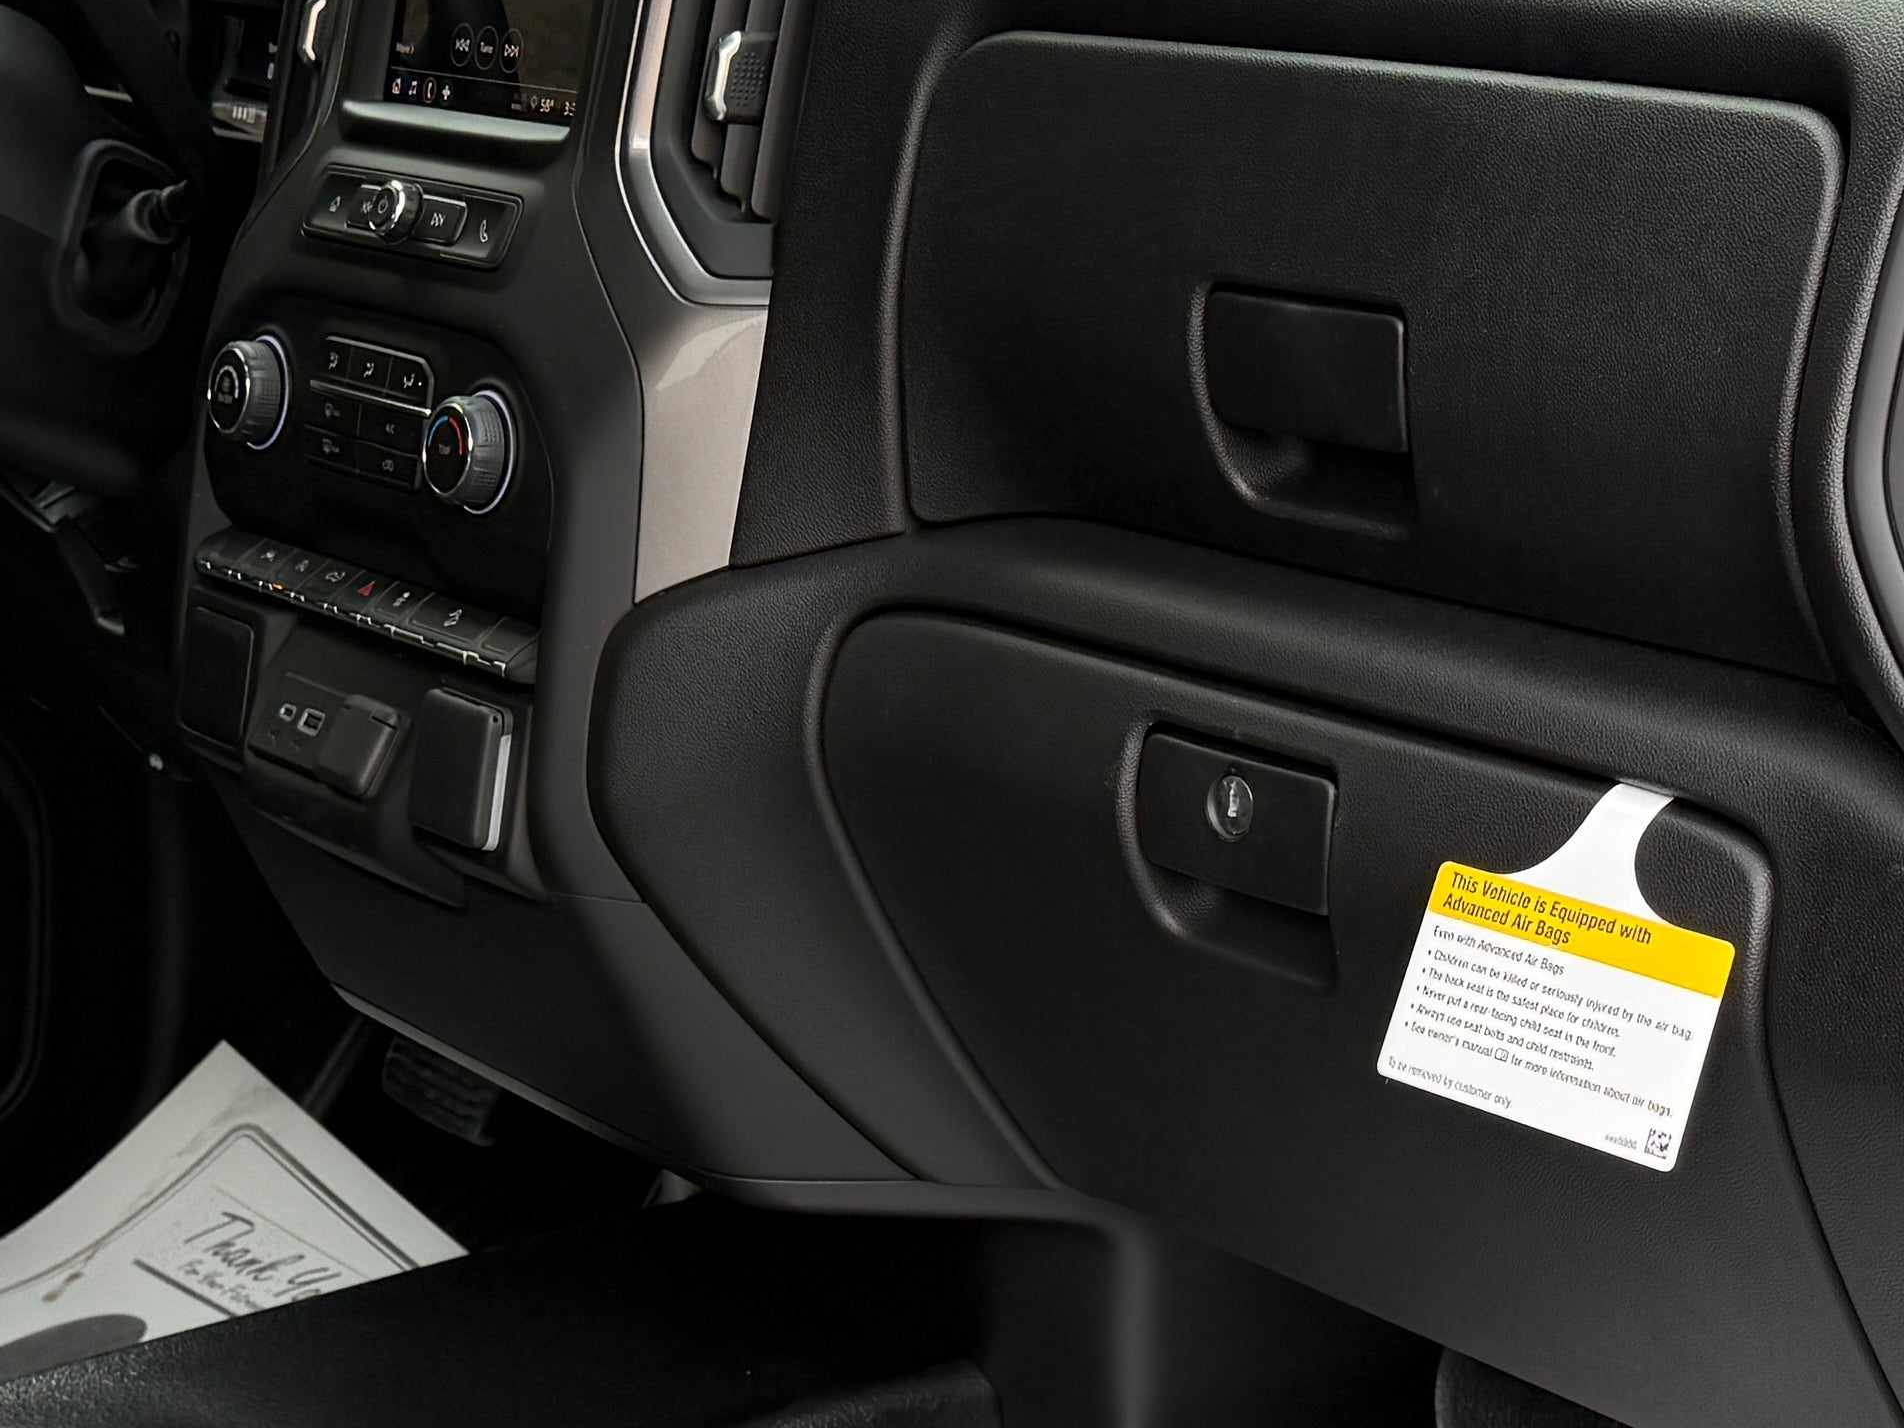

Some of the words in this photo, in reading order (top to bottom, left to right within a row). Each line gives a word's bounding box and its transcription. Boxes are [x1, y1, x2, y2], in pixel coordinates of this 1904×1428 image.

[1443, 891, 1510, 926] Advanced
[1510, 912, 1534, 933] Air
[1533, 919, 1572, 948] Bags
[1450, 871, 1480, 894] This
[1480, 880, 1532, 910] Vehicle
[1533, 896, 1549, 914] is
[1549, 900, 1617, 938] Equipped
[1618, 920, 1653, 945] with
[1524, 953, 1539, 967] Air
[1539, 957, 1566, 977] Bags
[184, 1211, 305, 1281] Thank
